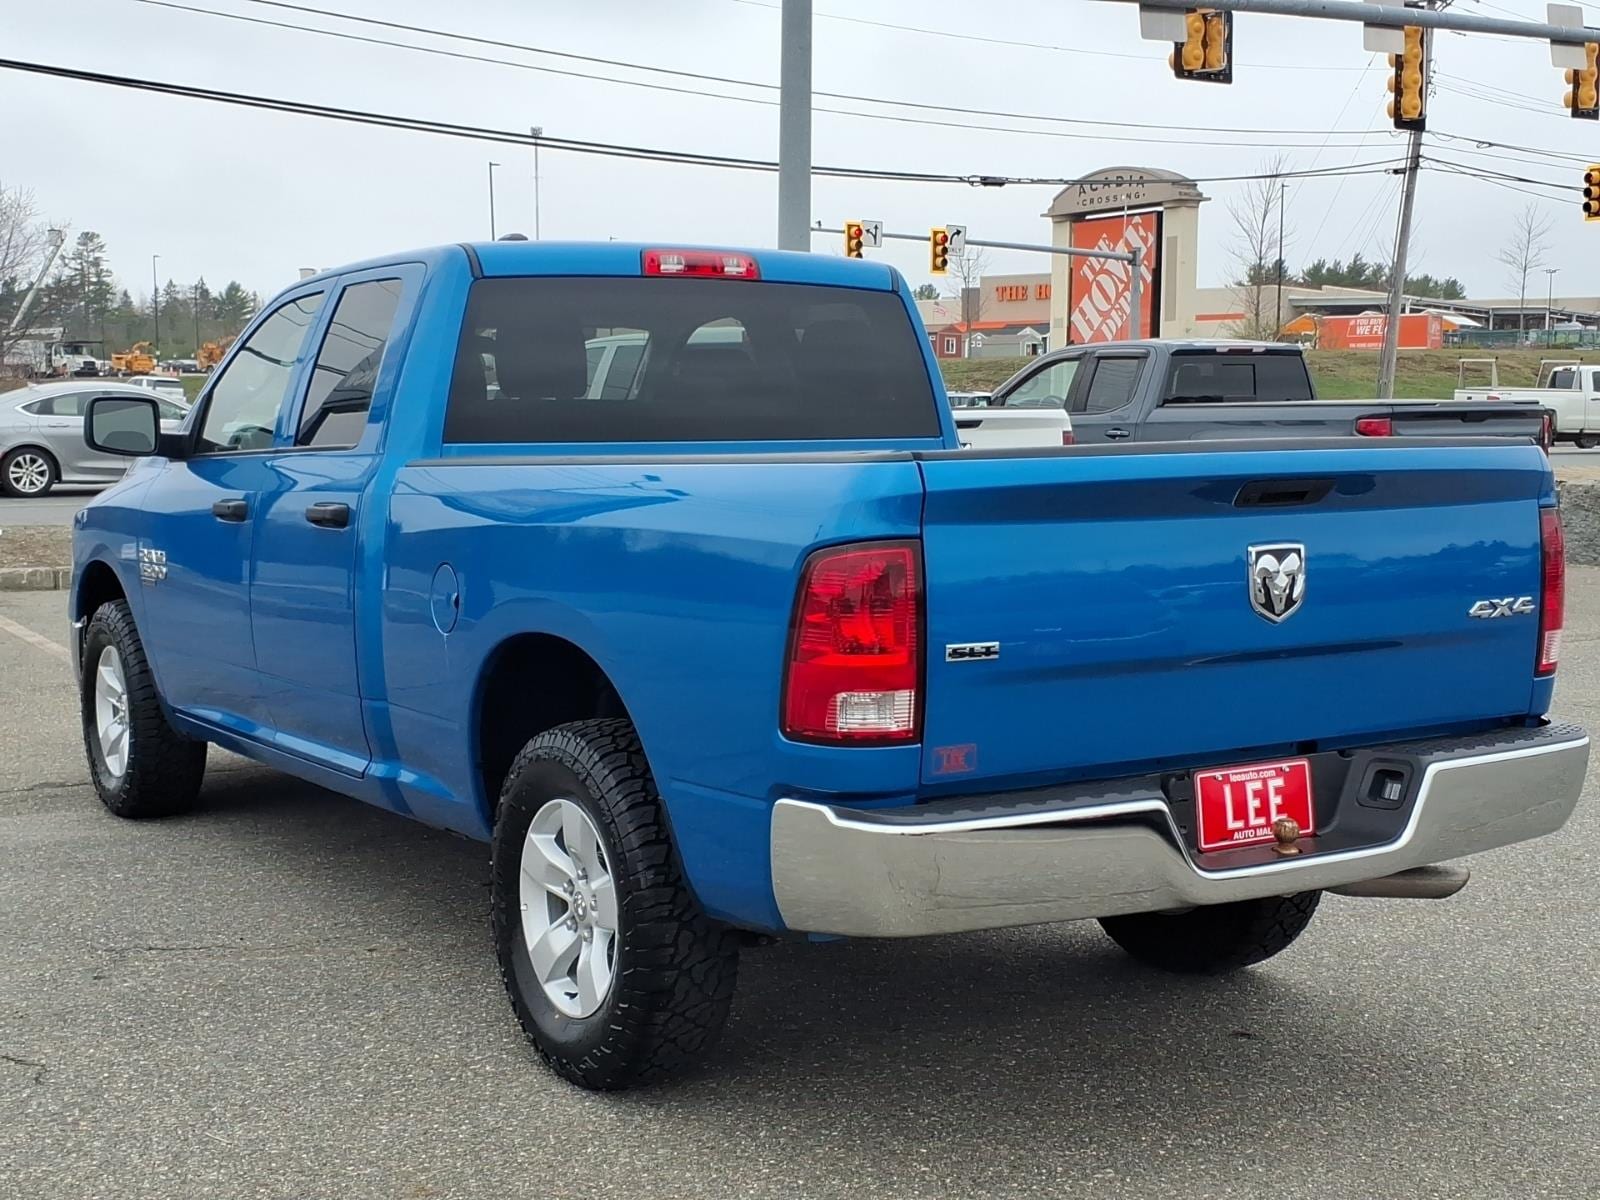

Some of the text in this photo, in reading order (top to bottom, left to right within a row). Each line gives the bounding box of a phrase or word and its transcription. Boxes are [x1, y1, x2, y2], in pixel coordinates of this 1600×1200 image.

[1078, 175, 1145, 197] ACADIA
[1080, 232, 1114, 283] THE
[1070, 215, 1154, 343] HOME
[996, 285, 1028, 302] THE
[1356, 325, 1370, 336] WE
[947, 643, 999, 660] SLT
[1229, 769, 1276, 783] leeauto.com
[1222, 777, 1289, 831] LEE
[1233, 826, 1274, 841] AUTO MAL
